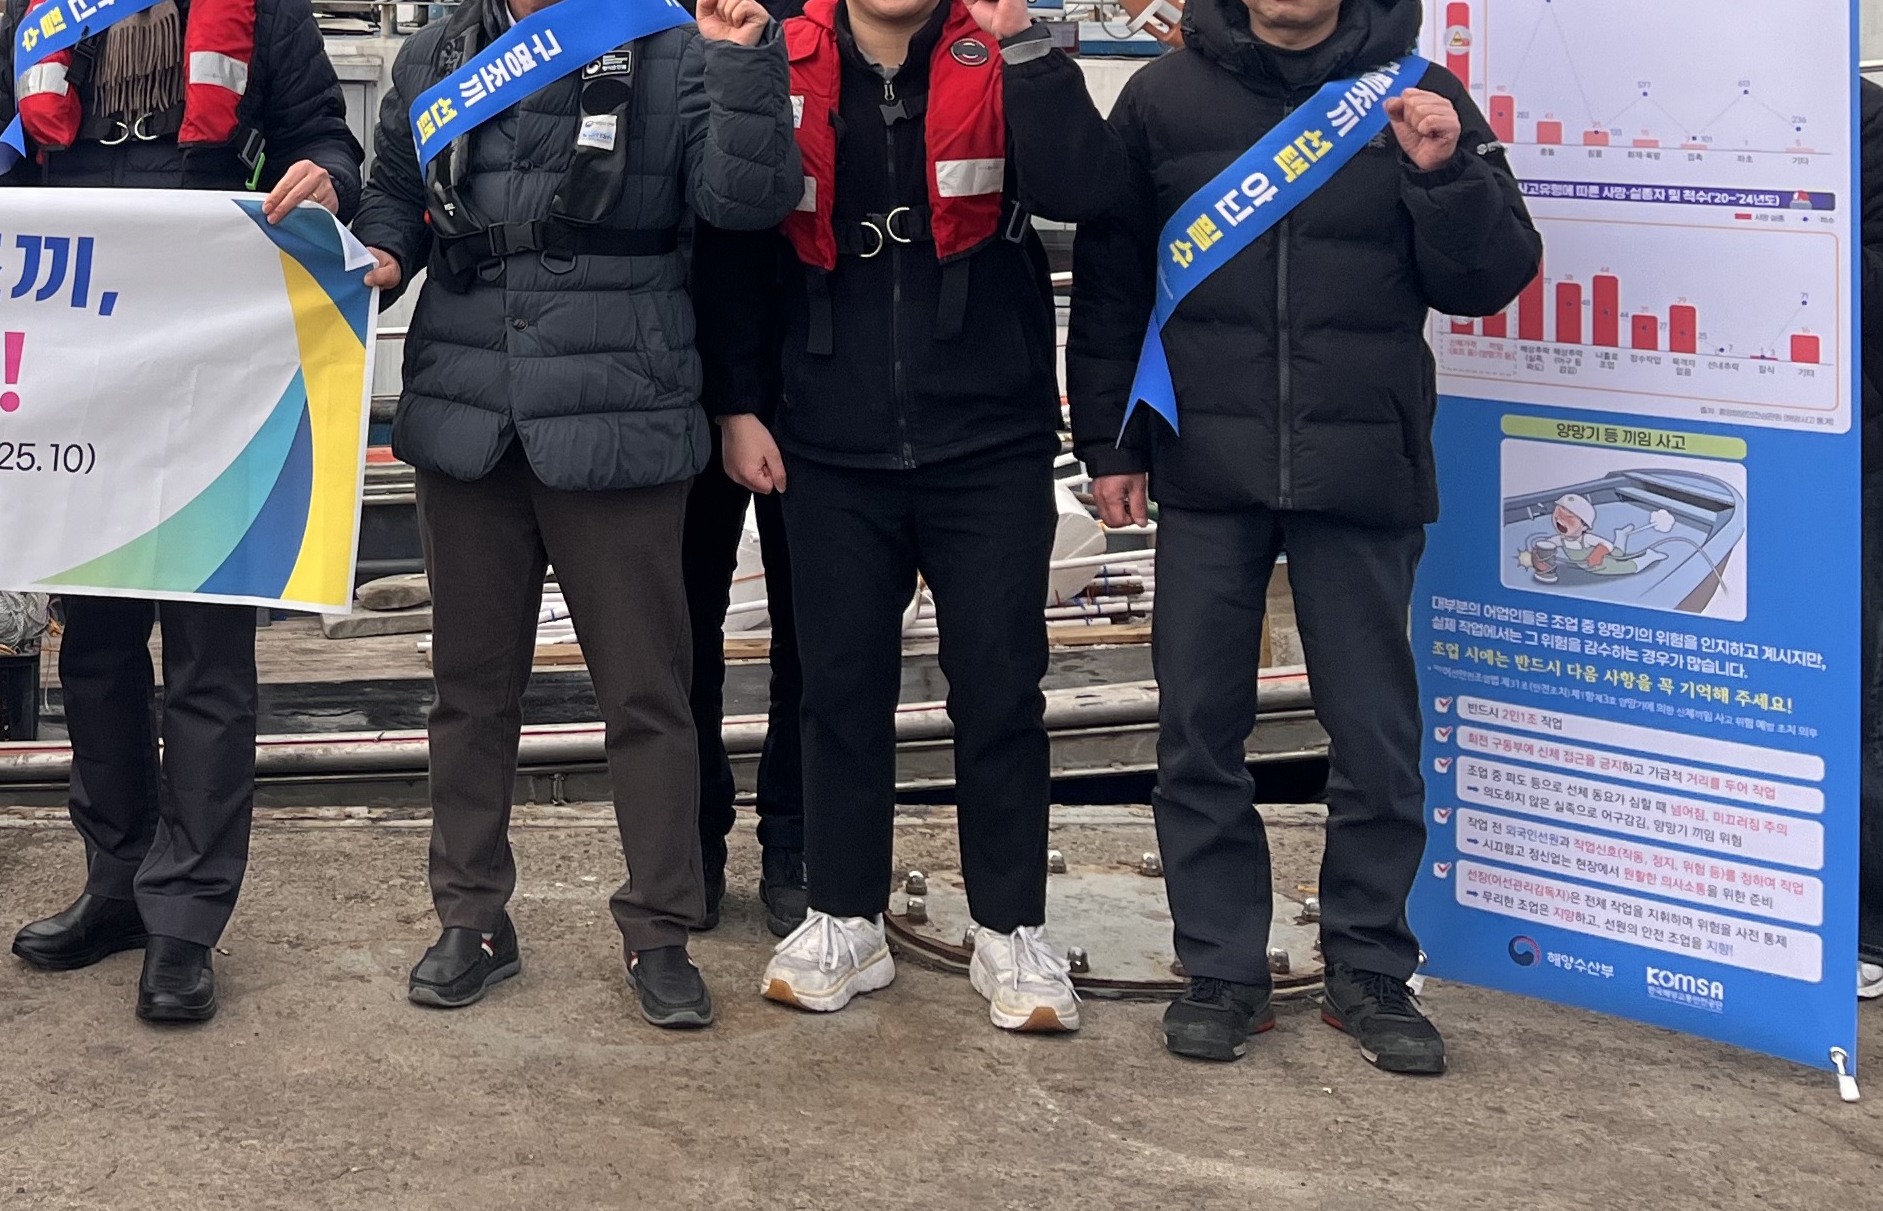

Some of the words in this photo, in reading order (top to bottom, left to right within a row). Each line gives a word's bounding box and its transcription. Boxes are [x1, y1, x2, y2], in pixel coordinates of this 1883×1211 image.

[21, 6, 68, 52] 필수
[459, 28, 563, 109] 구명조끼
[416, 96, 458, 146] 선택
[1274, 129, 1334, 183] 선택
[1215, 171, 1279, 228] 아닌
[1576, 185, 1600, 198] 따른
[1602, 186, 1666, 201] 사망·실종자
[1668, 189, 1681, 202] 및
[1169, 213, 1224, 269] 필수
[1798, 368, 1814, 377] 기타
[1557, 423, 1600, 441] 양망기
[1604, 428, 1619, 443] 등
[1623, 429, 1651, 447] 끼임
[1655, 433, 1686, 450] 사고
[1432, 595, 1481, 616] 대부분의
[1483, 604, 1548, 628] 어업인들은
[1551, 614, 1578, 632] 조업
[1581, 619, 1595, 634] 중
[1598, 622, 1653, 643] 양망기의
[1656, 631, 1697, 650] 위험을
[1700, 636, 1759, 659] 인지하고
[1762, 645, 1827, 671] 계시지만,
[1432, 615, 1456, 633] 실제
[1458, 619, 1522, 643] 작업에서는
[1525, 630, 1539, 646] 그
[1541, 633, 1581, 653] 위험을
[1584, 641, 1639, 662] 감수하는
[1642, 648, 1684, 669] 경우가
[1686, 656, 1748, 679] 많습니다.
[1432, 641, 1459, 660] 조업
[1464, 646, 1510, 668] 시에는
[1514, 654, 1561, 677] 반드시
[1567, 663, 1599, 683] 다음
[1603, 669, 1653, 692] 사항을
[1657, 677, 1674, 695] 꼭
[1680, 681, 1729, 704] 기억해
[1734, 689, 1793, 715] 주세요!
[1468, 703, 1499, 718] 반드시
[1502, 708, 1538, 725] 2인1조
[1541, 715, 1563, 730] 작업
[1468, 732, 1489, 747] 회전
[1492, 737, 1534, 756] 구동부에
[1537, 745, 1560, 761] 신체
[1563, 750, 1596, 768] 접근을
[1599, 756, 1645, 775] 금지하고
[1648, 765, 1683, 783] 가급적
[1686, 772, 1720, 790] 거리를
[1725, 779, 1748, 795] 두어
[1752, 783, 1776, 800] 작업
[1467, 764, 1488, 779] 조업
[1491, 769, 1502, 782] 중
[1505, 771, 1527, 787] 파도
[1530, 776, 1563, 793] 등으로
[1567, 783, 1589, 798] 선체
[1592, 788, 1625, 805] 동요가
[1629, 794, 1652, 810] 심할
[1655, 801, 1667, 814] 때
[1713, 812, 1760, 832] 미끄러짐
[1764, 820, 1788, 837] 주의
[1483, 786, 1526, 806] 의도하지
[1529, 795, 1550, 809] 않은
[1553, 801, 1597, 819] 실족으로
[1601, 809, 1650, 831] 어구감김,
[1653, 819, 1688, 837] 양망기
[1692, 826, 1715, 843] 끼임
[1719, 831, 1743, 848] 위험
[1467, 816, 1488, 832] 작업
[1491, 821, 1502, 835] 전
[1505, 824, 1570, 848] 외국인선원과
[1652, 854, 1678, 871] 정지,
[1683, 860, 1706, 877] 위험
[1709, 865, 1736, 883] 등)를
[1740, 871, 1776, 890] 정하여
[1482, 838, 1526, 857] 시끄럽고
[1529, 847, 1572, 868] 정신없는
[1575, 858, 1620, 878] 현장에서
[1624, 866, 1657, 885] 원활한
[1660, 875, 1718, 898] 의사소통을
[1722, 887, 1746, 904] 위한
[1749, 893, 1773, 910] 준비
[1467, 868, 1581, 904] 선장(어선관리감독자)은
[1584, 894, 1607, 910] 전체
[1610, 900, 1643, 919] 작업을
[1647, 907, 1693, 927] 지휘하며
[1697, 918, 1731, 937] 위험을
[1735, 926, 1759, 943] 사전
[1763, 931, 1788, 949] 통제
[1482, 890, 1514, 909] 무리한
[1517, 899, 1549, 916] 조업은
[1553, 906, 1601, 929] 지양하고,
[1604, 917, 1638, 936] 선원의
[1641, 925, 1665, 942] 안전
[1668, 931, 1702, 950] 조업을
[1706, 939, 1734, 957] 지향!
[1546, 951, 1614, 979] 해양수산부
[1646, 966, 1724, 1000] KOMSA
